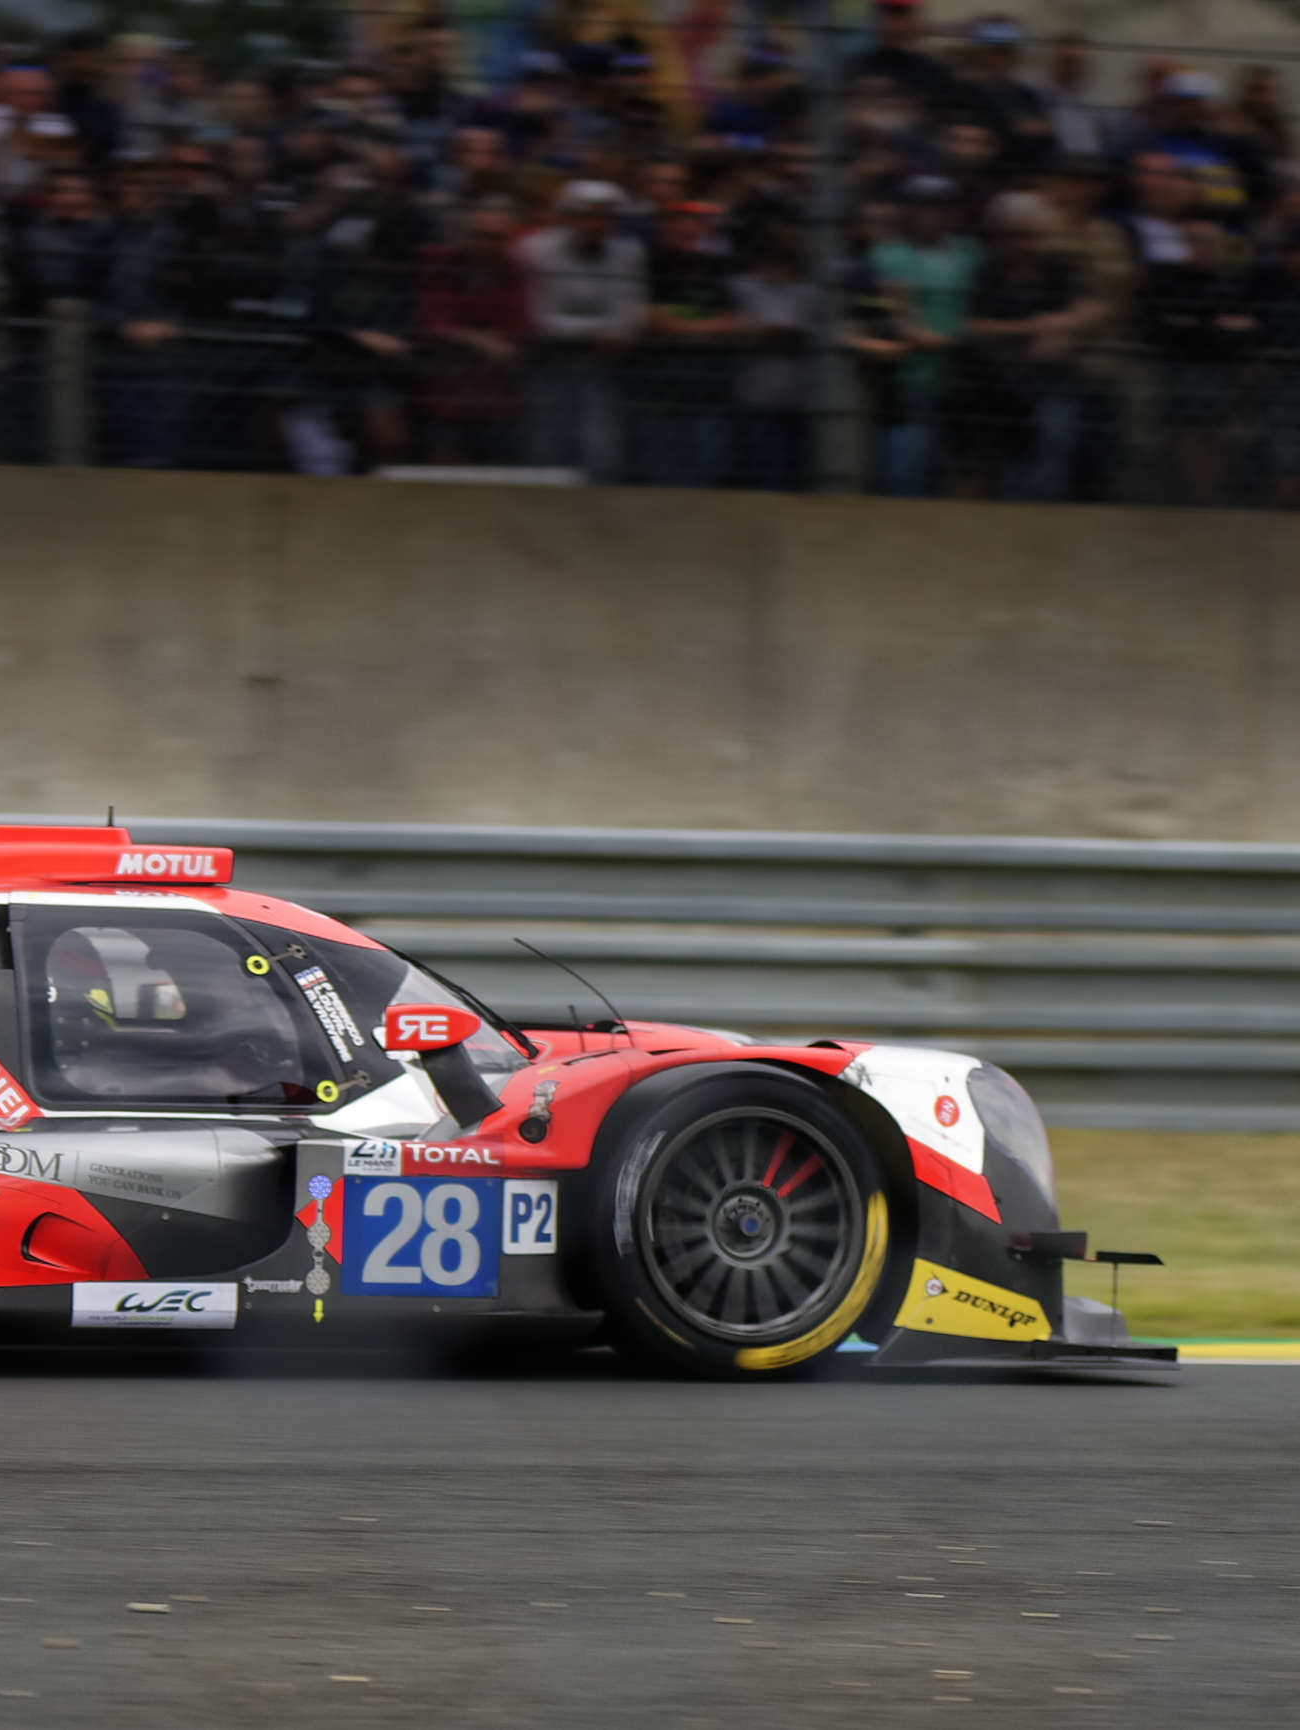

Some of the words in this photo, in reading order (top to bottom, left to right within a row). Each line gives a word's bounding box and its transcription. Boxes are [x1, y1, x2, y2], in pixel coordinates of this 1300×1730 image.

[116, 853, 217, 876] MOTUL
[406, 1143, 499, 1165] TOTAL
[510, 1193, 553, 1244] P2
[362, 1182, 481, 1287] 28
[115, 1290, 212, 1312] WEC
[954, 1290, 1037, 1326] DUNLOP
